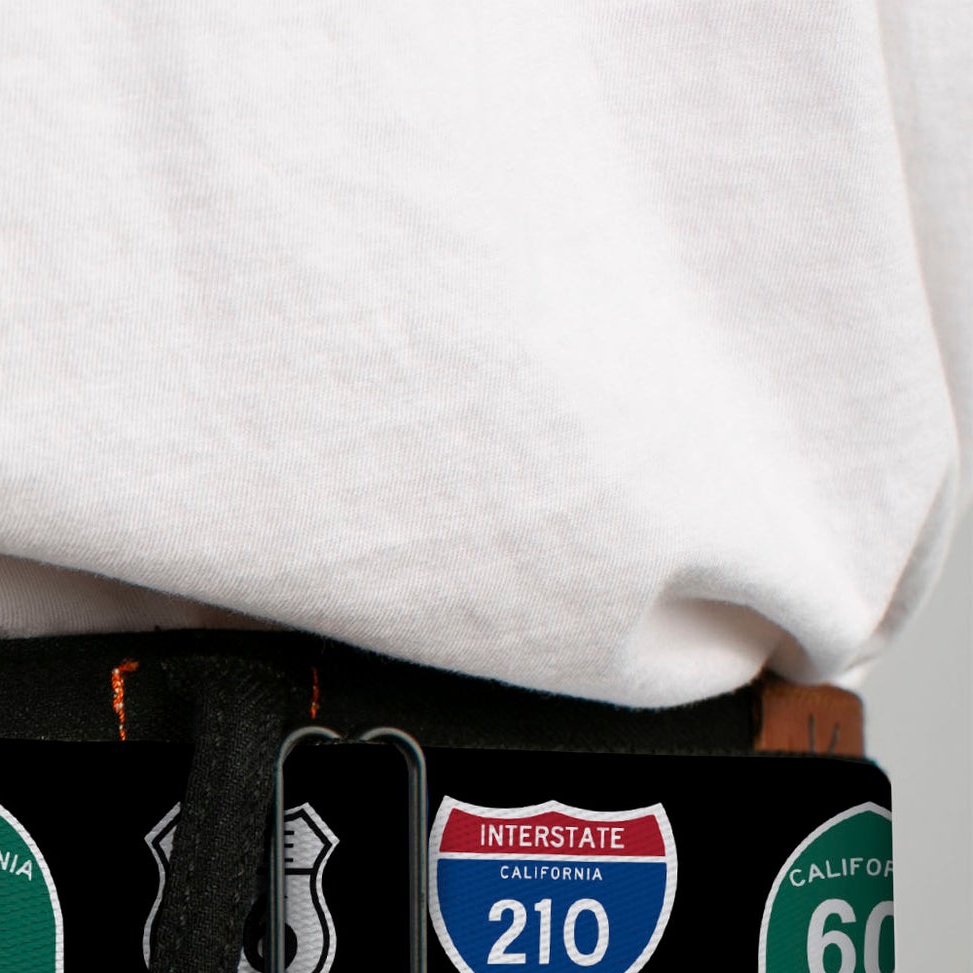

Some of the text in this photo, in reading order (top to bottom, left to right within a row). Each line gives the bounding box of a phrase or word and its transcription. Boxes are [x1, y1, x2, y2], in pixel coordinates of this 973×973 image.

[480, 824, 625, 849] INTERSTATE
[499, 865, 603, 881] CALIFORNIA
[486, 898, 610, 967] 210
